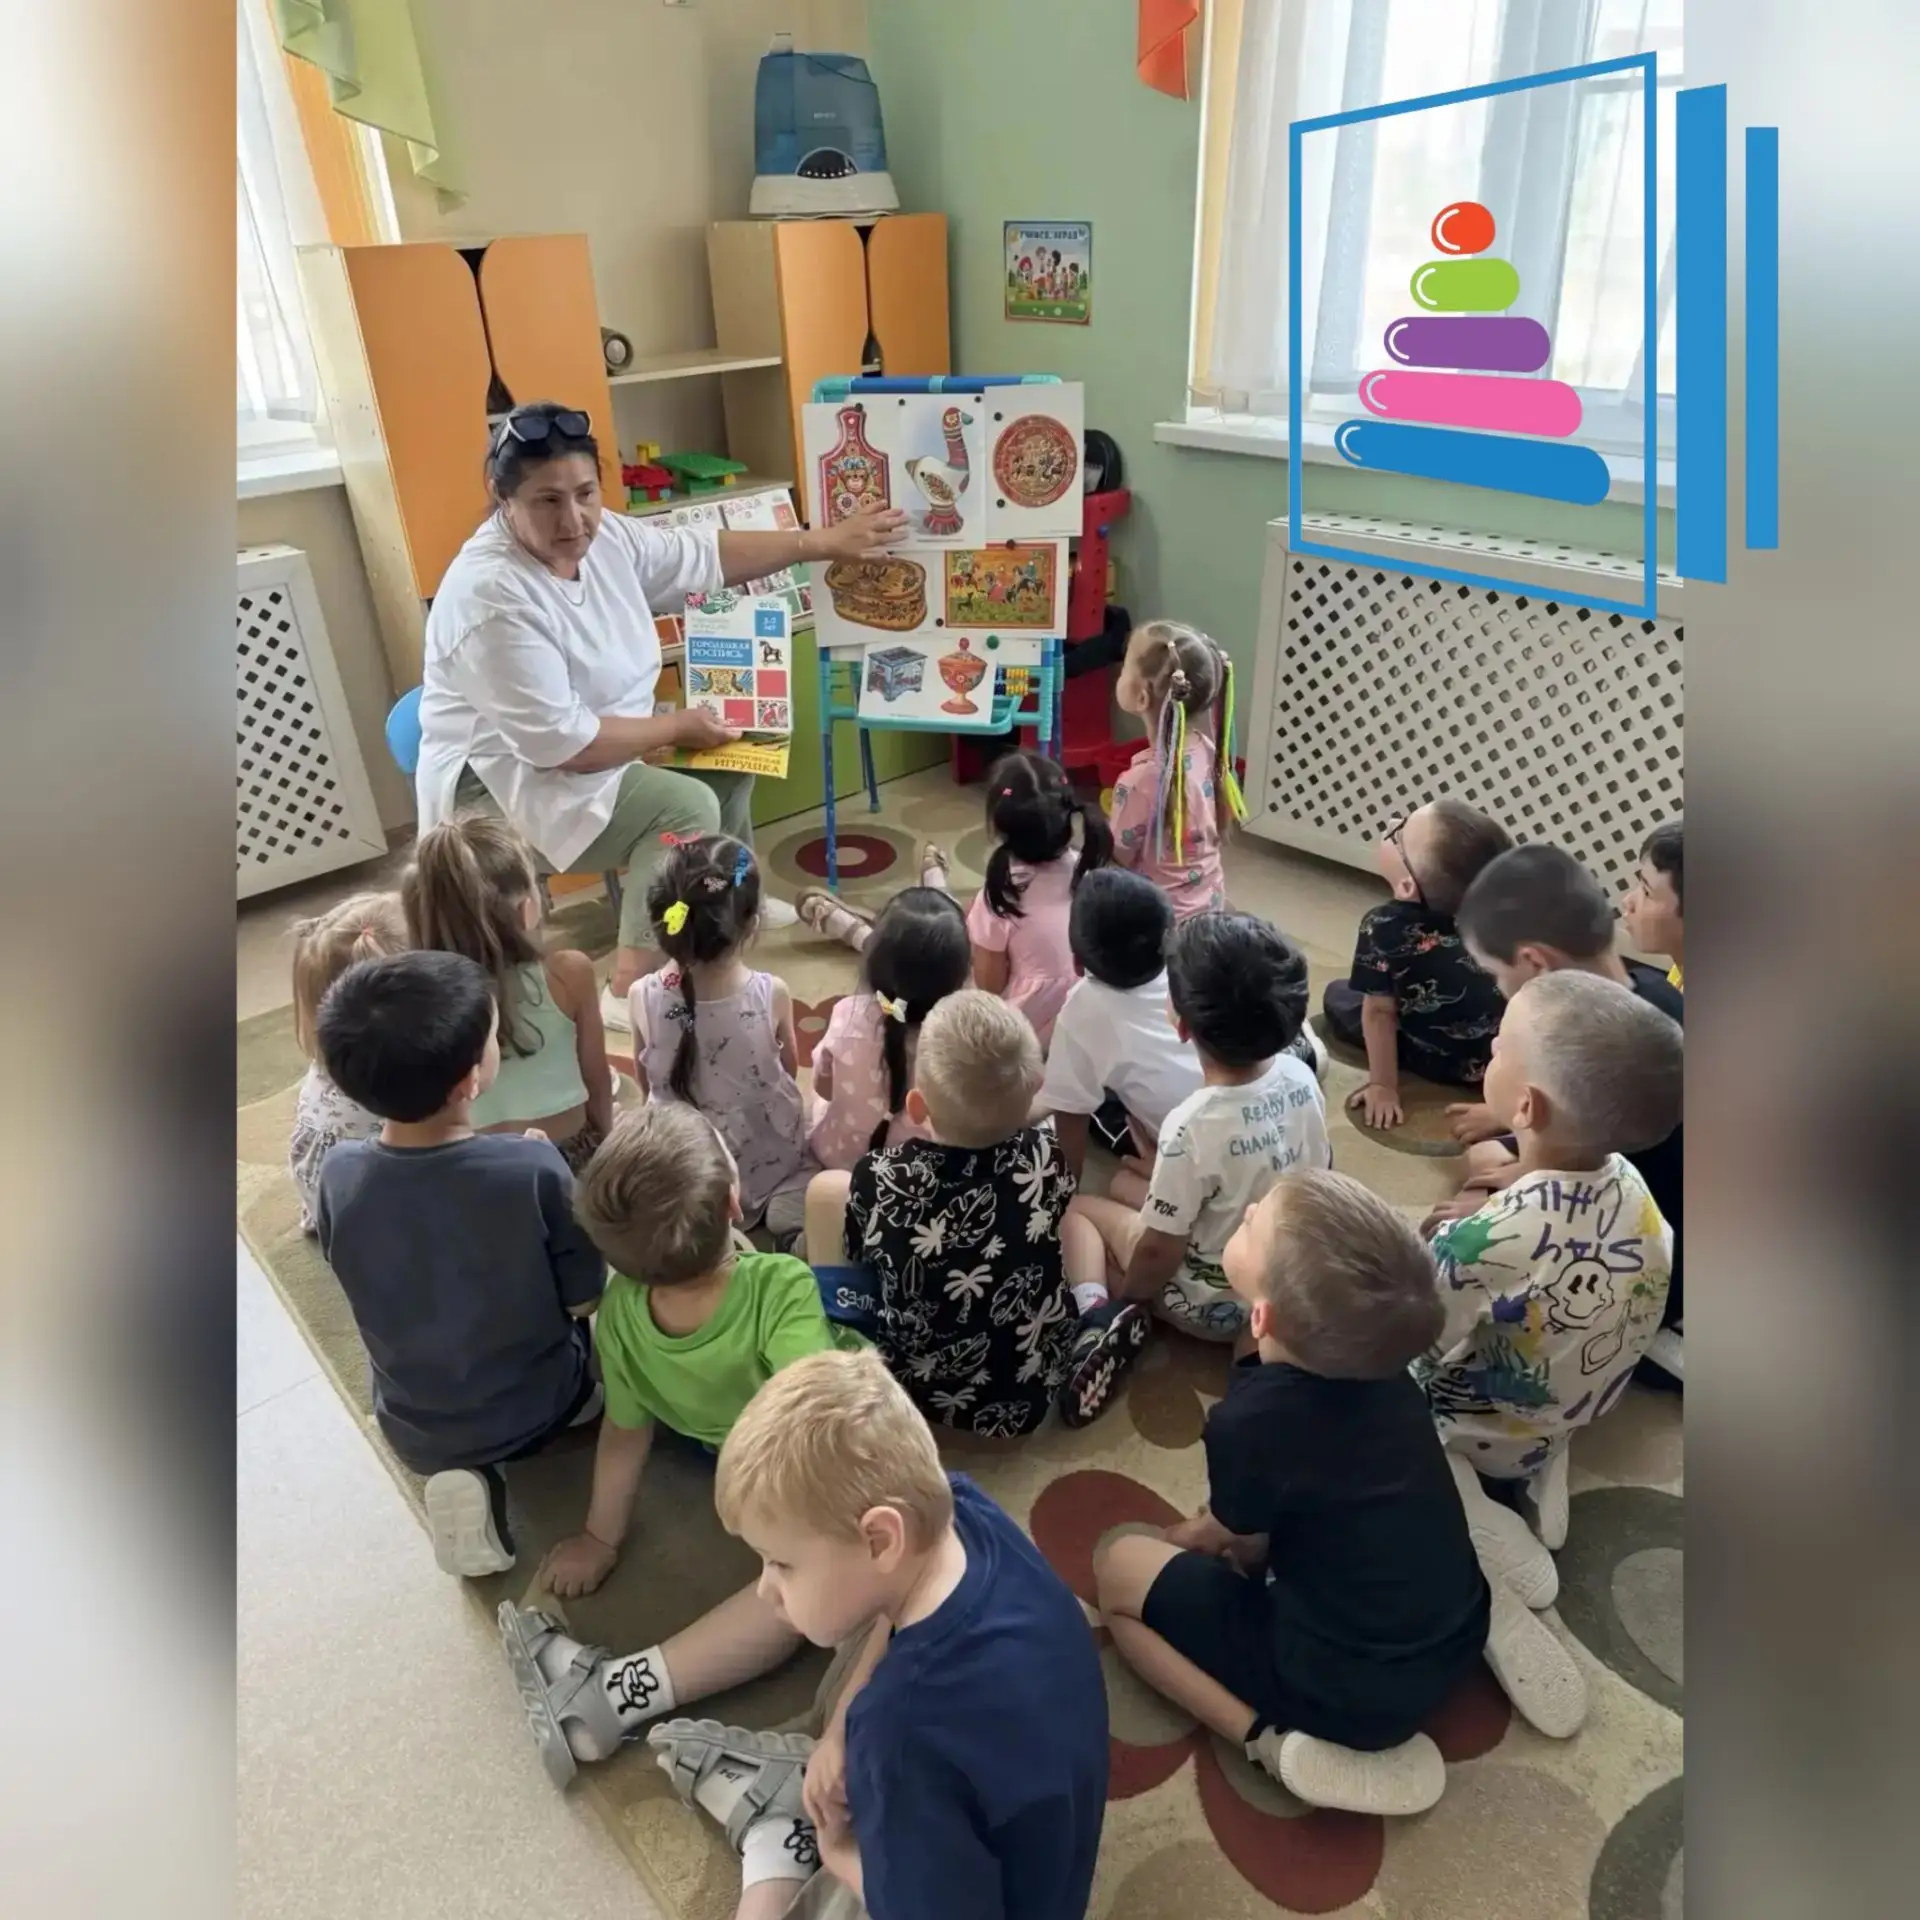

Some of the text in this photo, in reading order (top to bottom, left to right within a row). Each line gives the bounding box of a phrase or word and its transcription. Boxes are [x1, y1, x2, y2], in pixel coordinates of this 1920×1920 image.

[714, 758, 780, 774] ИГРУШКА
[1241, 1085, 1313, 1126] READY FOR
